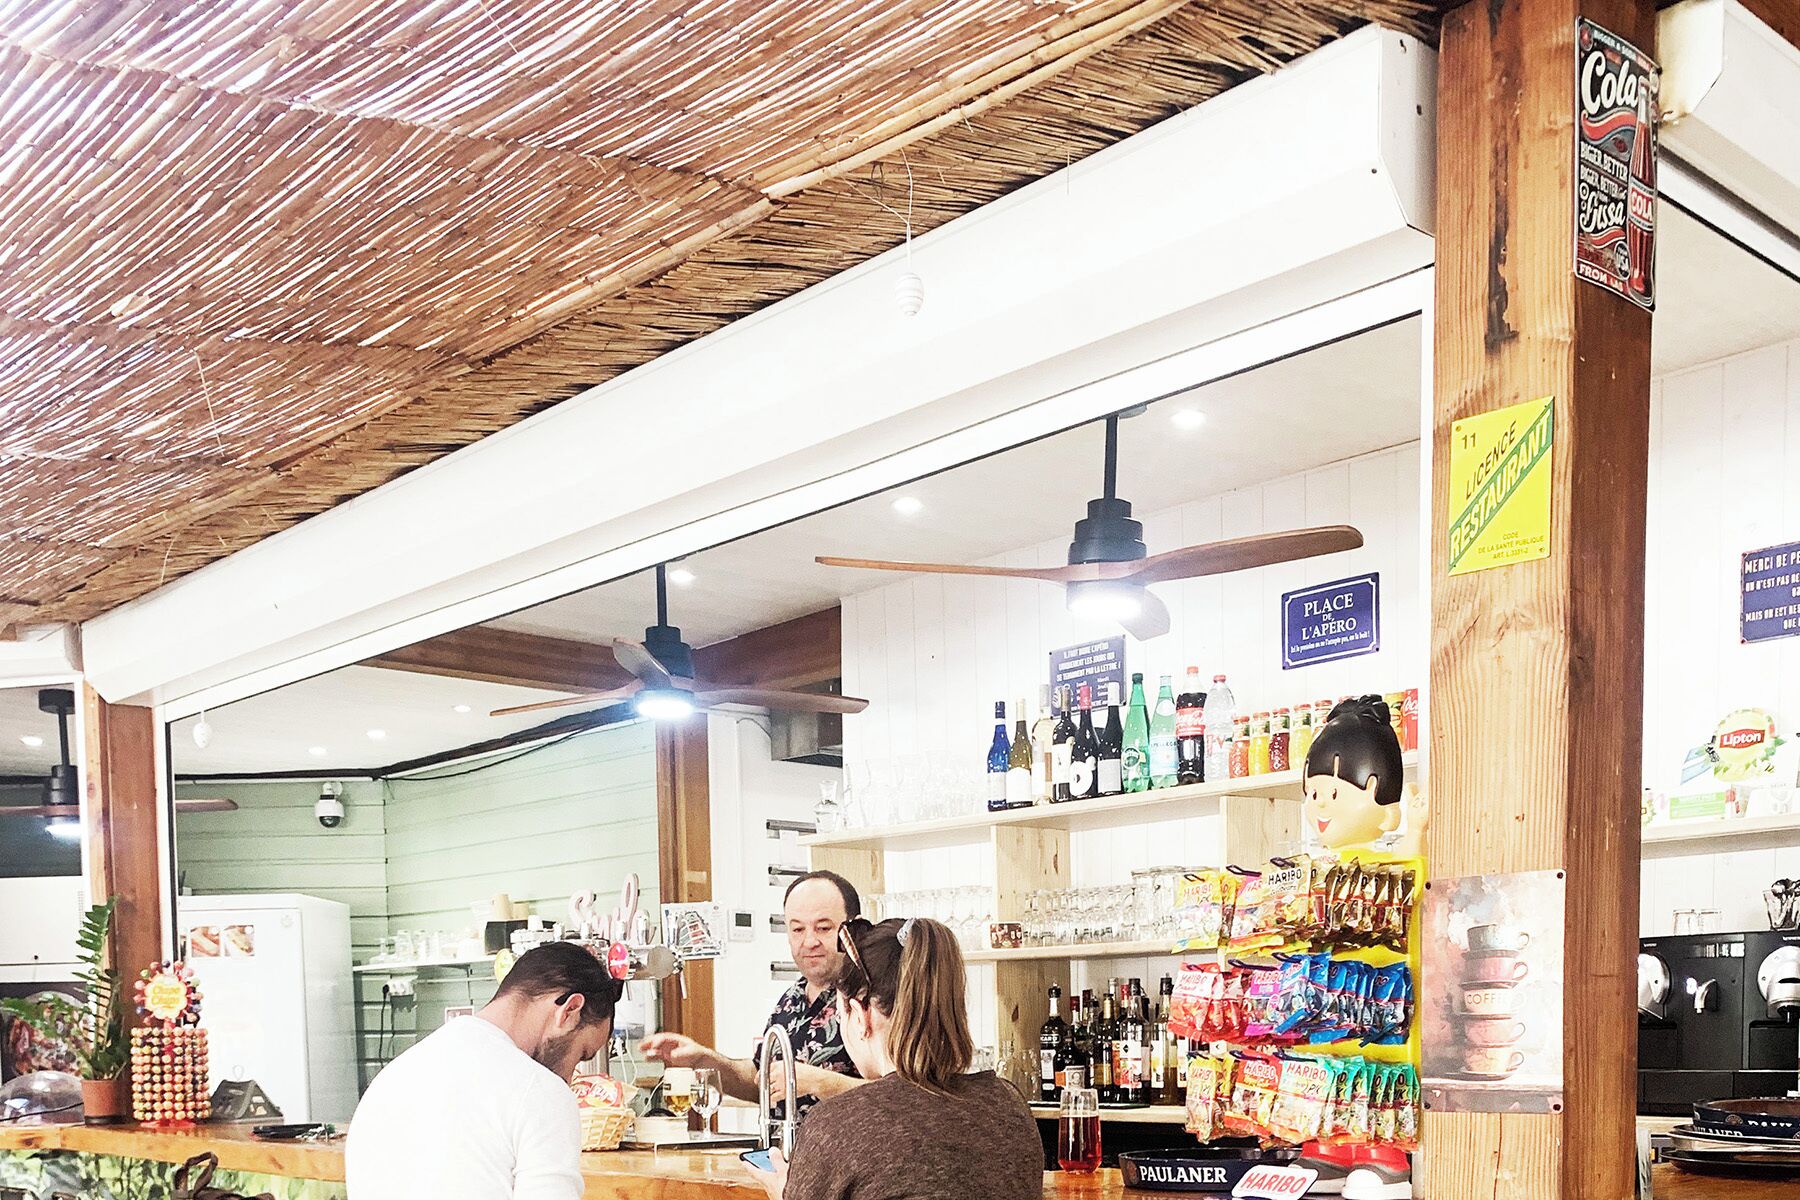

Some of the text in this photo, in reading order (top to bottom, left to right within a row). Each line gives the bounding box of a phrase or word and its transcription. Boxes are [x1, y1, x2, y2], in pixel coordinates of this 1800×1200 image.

[1581, 50, 1638, 114] Cola
[1631, 189, 1653, 222] COLA
[1579, 263, 1608, 284] FROM
[1462, 432, 1476, 450] 11
[1466, 420, 1517, 500] LICENCE
[1451, 408, 1551, 565] RESTAURANT
[1516, 535, 1545, 547] PUBLIQUE
[1745, 557, 1773, 574] MERCI
[1756, 577, 1775, 591] N'EST
[1776, 574, 1790, 587] PAS
[1304, 592, 1354, 618] PLACE
[1745, 610, 1763, 623] MAIS
[1775, 605, 1788, 618] EST
[1322, 613, 1332, 621] DE
[1302, 617, 1357, 641] L'APÉRO
[1723, 732, 1762, 746] Lipton
[1268, 868, 1302, 886] HARIBO
[1286, 1062, 1327, 1081] HARIBO
[1139, 1165, 1228, 1184] PAULANER
[1241, 1171, 1306, 1194] HARIBO
